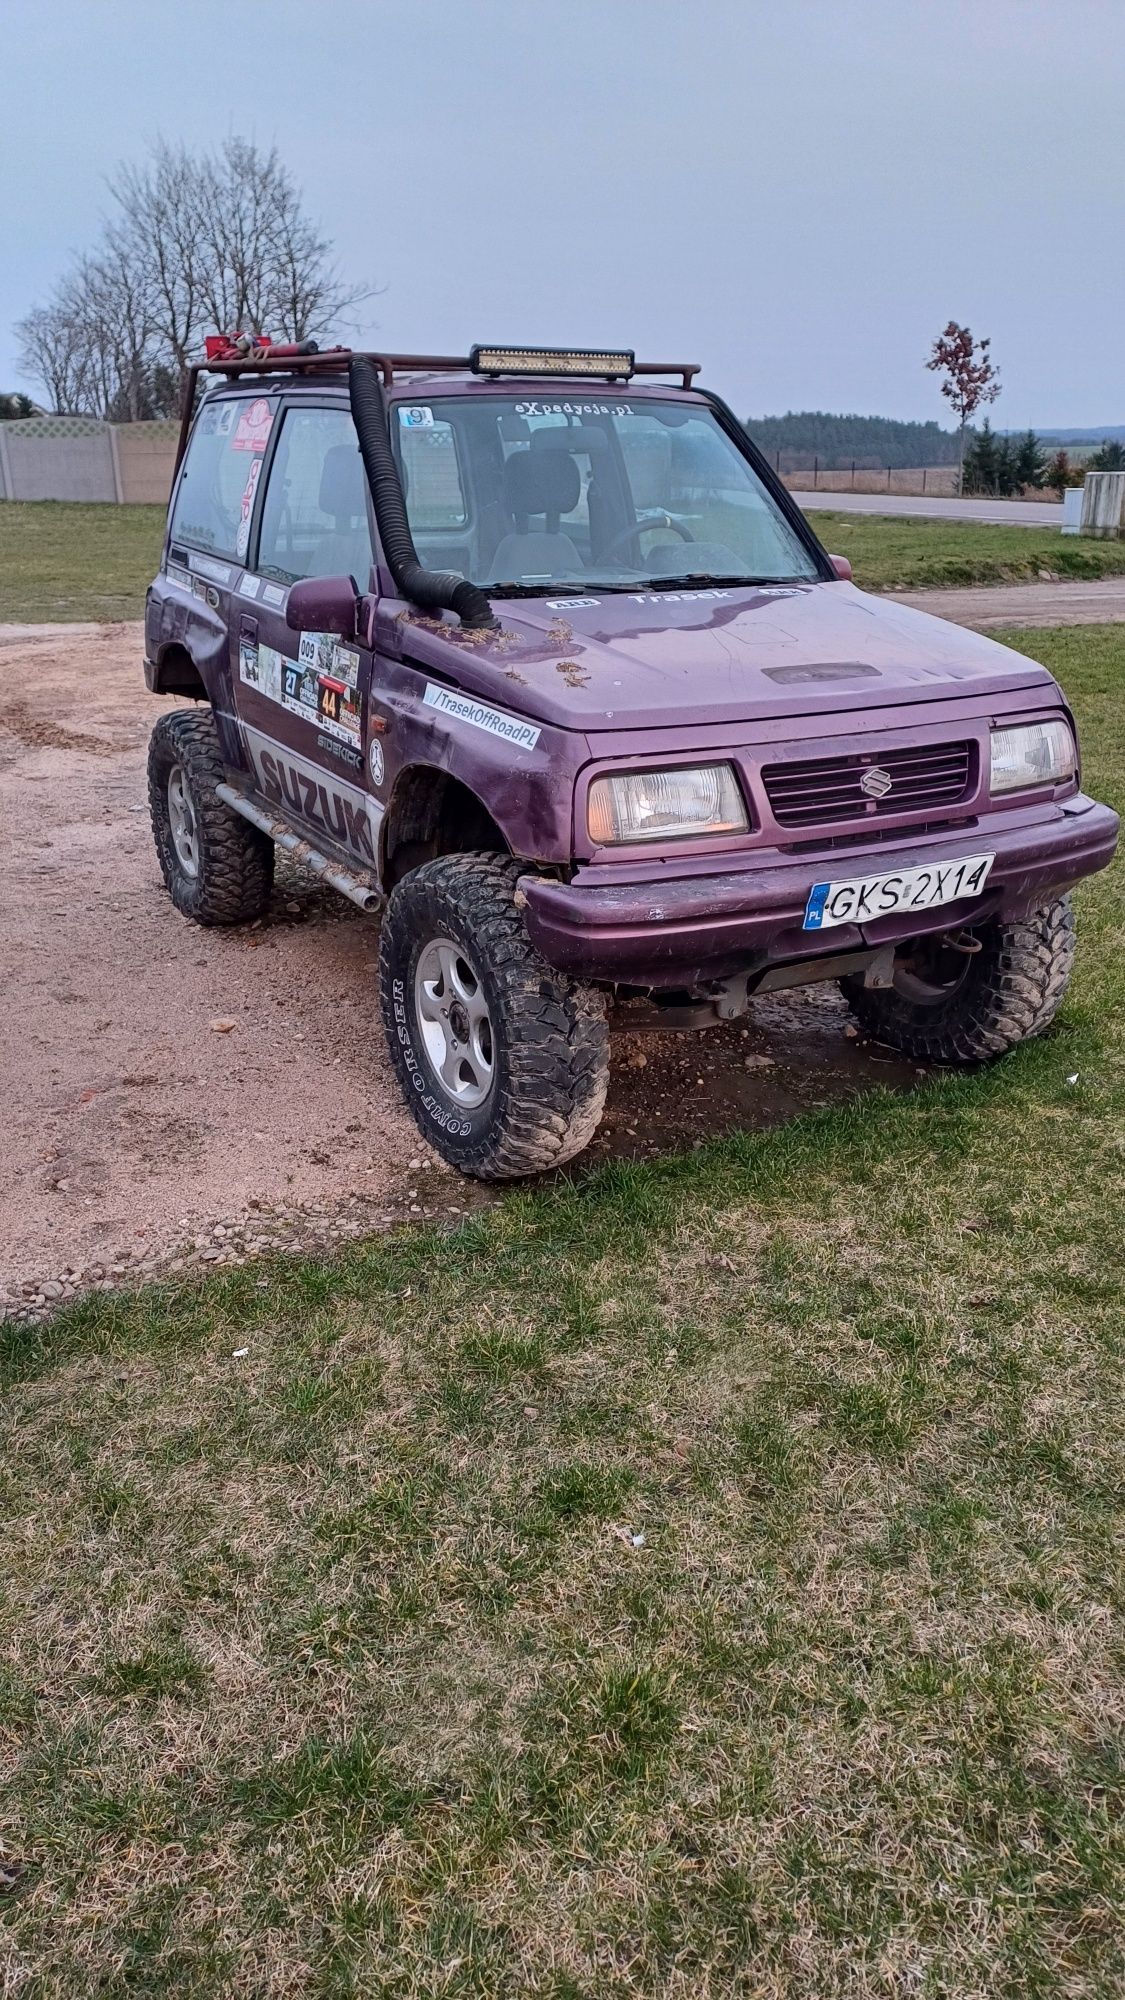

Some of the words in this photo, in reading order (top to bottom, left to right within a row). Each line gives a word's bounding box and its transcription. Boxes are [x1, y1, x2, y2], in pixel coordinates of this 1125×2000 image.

[515, 402, 634, 416] eXpedycja.pl
[627, 590, 735, 604] Trasek
[301, 640, 314, 659] 009
[322, 689, 336, 718] 44
[317, 734, 363, 769] SIDEKICK
[830, 877, 903, 919] GKS
[910, 860, 988, 906] 2X14
[808, 910, 821, 921] PL
[392, 978, 472, 1137] COMFORSER
